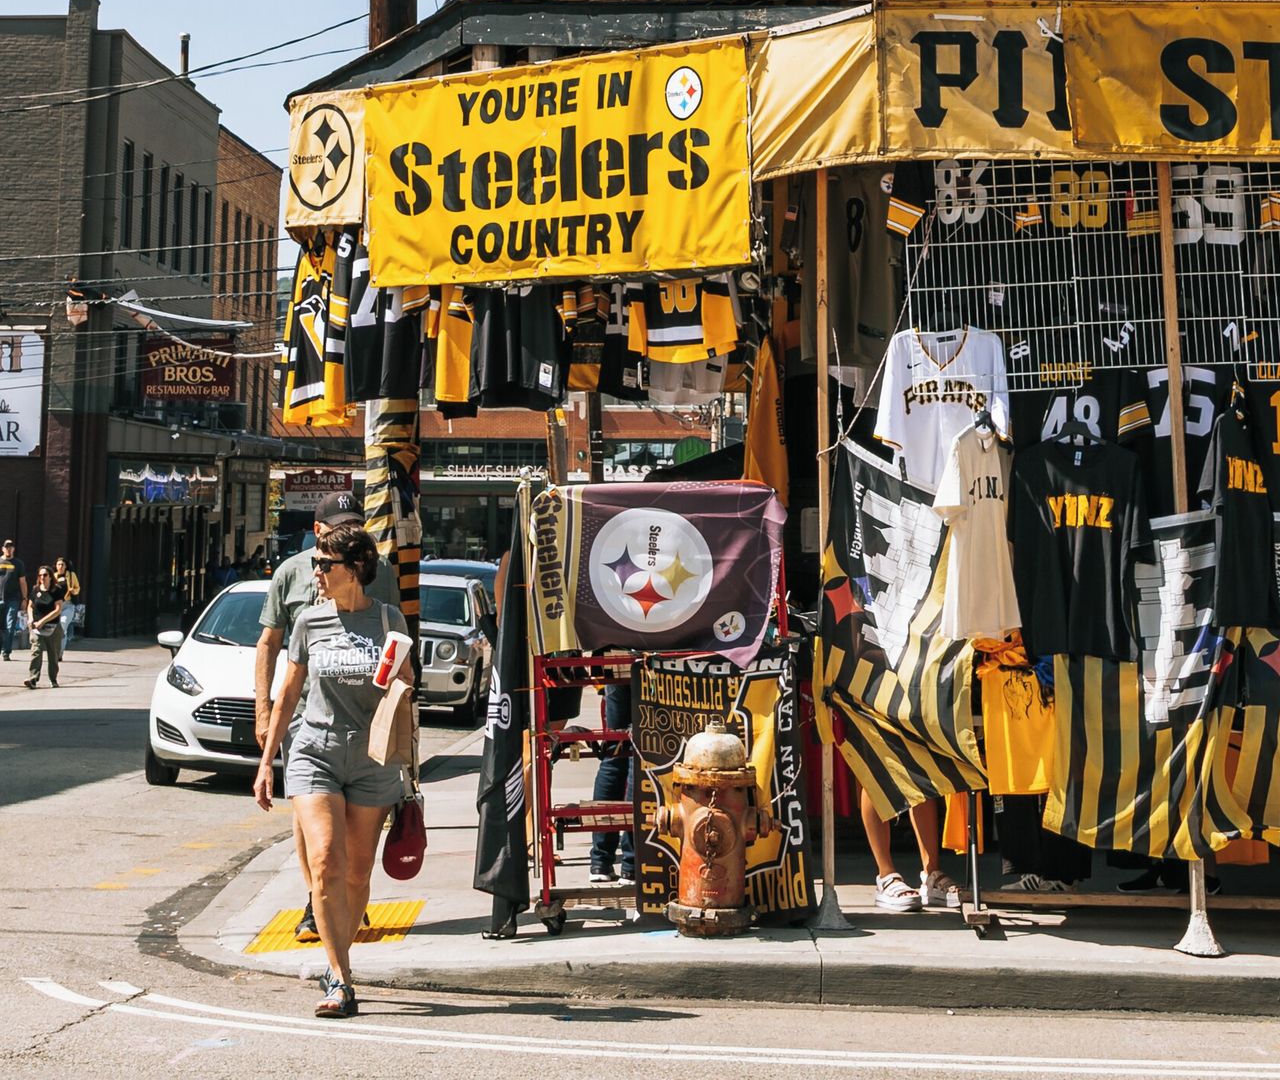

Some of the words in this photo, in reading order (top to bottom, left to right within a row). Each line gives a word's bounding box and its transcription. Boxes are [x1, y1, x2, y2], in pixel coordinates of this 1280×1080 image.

[458, 77, 581, 127] YOU'RE
[596, 70, 633, 109] IN
[292, 153, 324, 166] Steelers
[389, 125, 711, 218] Steelers
[337, 232, 354, 258] 5
[450, 210, 646, 266] COUNTRY
[845, 197, 865, 254] 8
[146, 384, 202, 395] RESTAURANT
[203, 386, 211, 395] &
[211, 385, 231, 397] BAR
[164, 366, 217, 385] BROS.
[1040, 360, 1093, 382] DUPREE
[903, 379, 988, 416] PIRATES
[1147, 366, 1217, 438] 75
[1040, 395, 1102, 447] 48
[293, 474, 346, 485] JO-MAR
[447, 464, 493, 478] SHAKE
[1226, 455, 1268, 495] YINZ
[1047, 493, 1115, 529] YINZ
[531, 493, 565, 620] Steelers
[647, 524, 662, 567] Steelers
[328, 667, 371, 677] COLORADO
[337, 676, 365, 687] Original
[640, 669, 724, 710] PITTSBURGH
[781, 746, 799, 798] FAN
[641, 850, 666, 915] EST.
